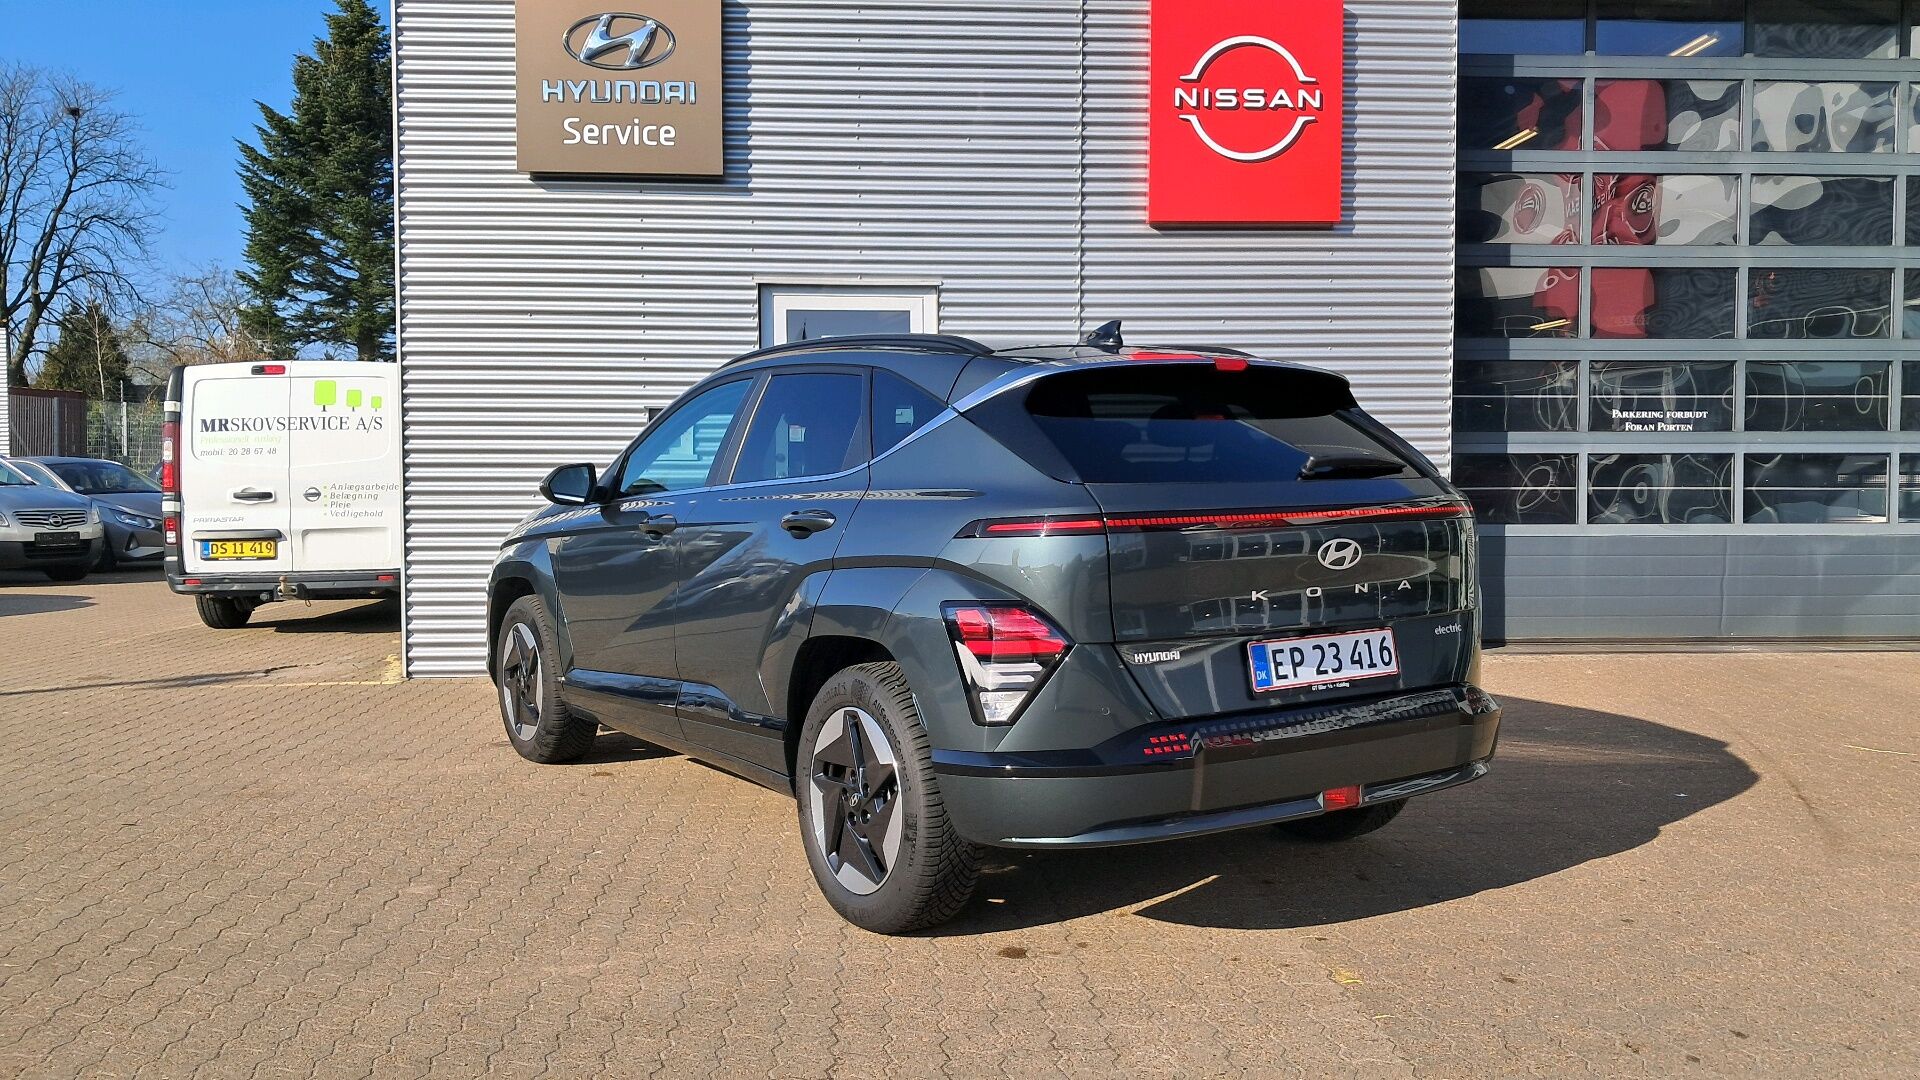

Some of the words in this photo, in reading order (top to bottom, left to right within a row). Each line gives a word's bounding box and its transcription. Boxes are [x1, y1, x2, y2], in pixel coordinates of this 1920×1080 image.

[542, 79, 697, 104] HYUNDAI
[1174, 87, 1322, 109] NISSAN
[562, 117, 676, 146] Service
[1611, 409, 1663, 419] PARKERING
[200, 416, 350, 433] MRSKOVSERVICE
[356, 416, 383, 434] A/S
[1625, 421, 1655, 431] FORAN
[1657, 421, 1693, 431] PORTEN
[228, 448, 238, 456] 20
[240, 447, 251, 456] 28
[330, 492, 379, 501] Belægning
[330, 501, 351, 510] Pleje
[210, 542, 228, 555] DS
[232, 542, 245, 555] 11
[250, 541, 273, 554] 419
[1251, 579, 1412, 601] KONA
[1434, 622, 1463, 635] electric
[1134, 650, 1181, 663] HYUNDAI
[1271, 646, 1305, 680] EP
[1312, 642, 1343, 675] 23
[1350, 635, 1393, 670] 416
[1256, 670, 1268, 681] DK
